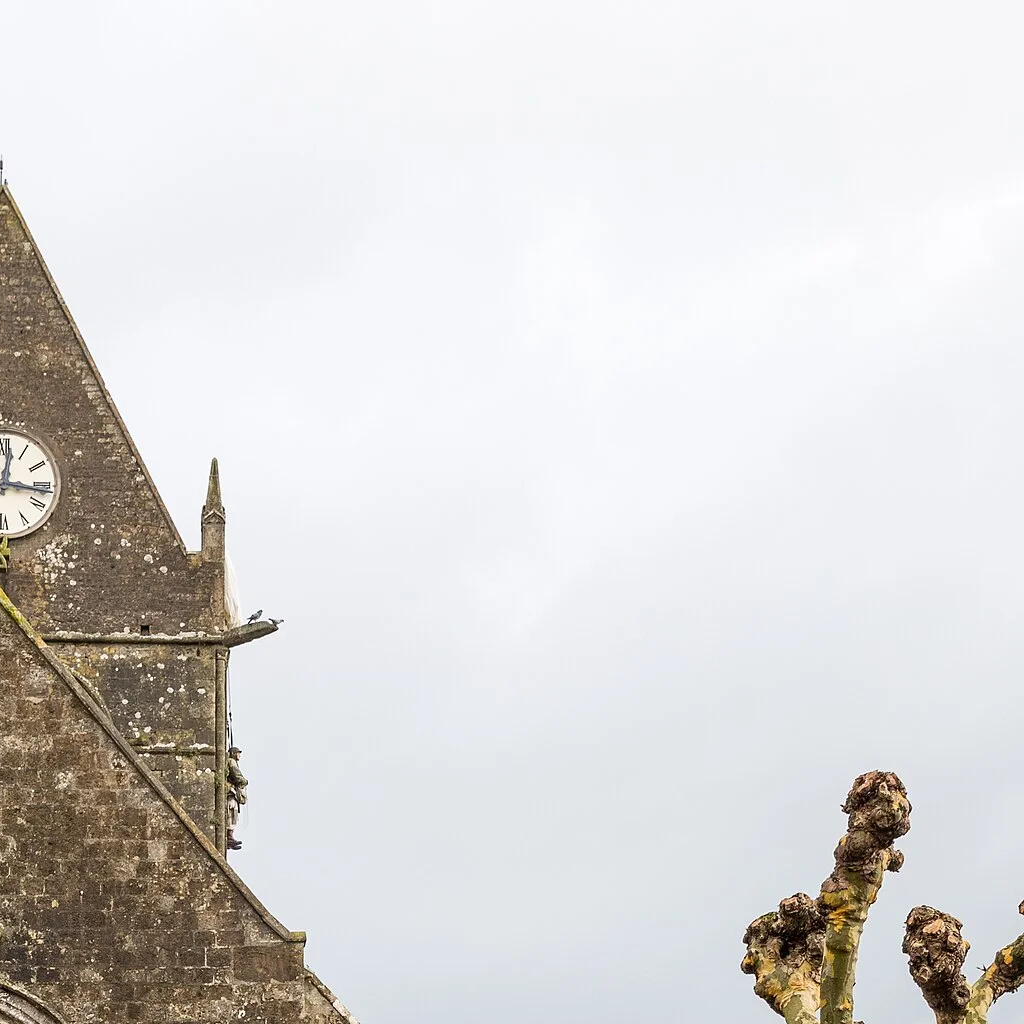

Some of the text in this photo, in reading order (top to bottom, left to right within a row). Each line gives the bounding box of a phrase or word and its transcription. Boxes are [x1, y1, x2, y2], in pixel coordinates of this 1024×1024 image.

[18, 444, 29, 460] I
[28, 460, 46, 473] II
[29, 496, 46, 512] IV
[0, 513, 9, 530] VI
[18, 509, 30, 526] V
